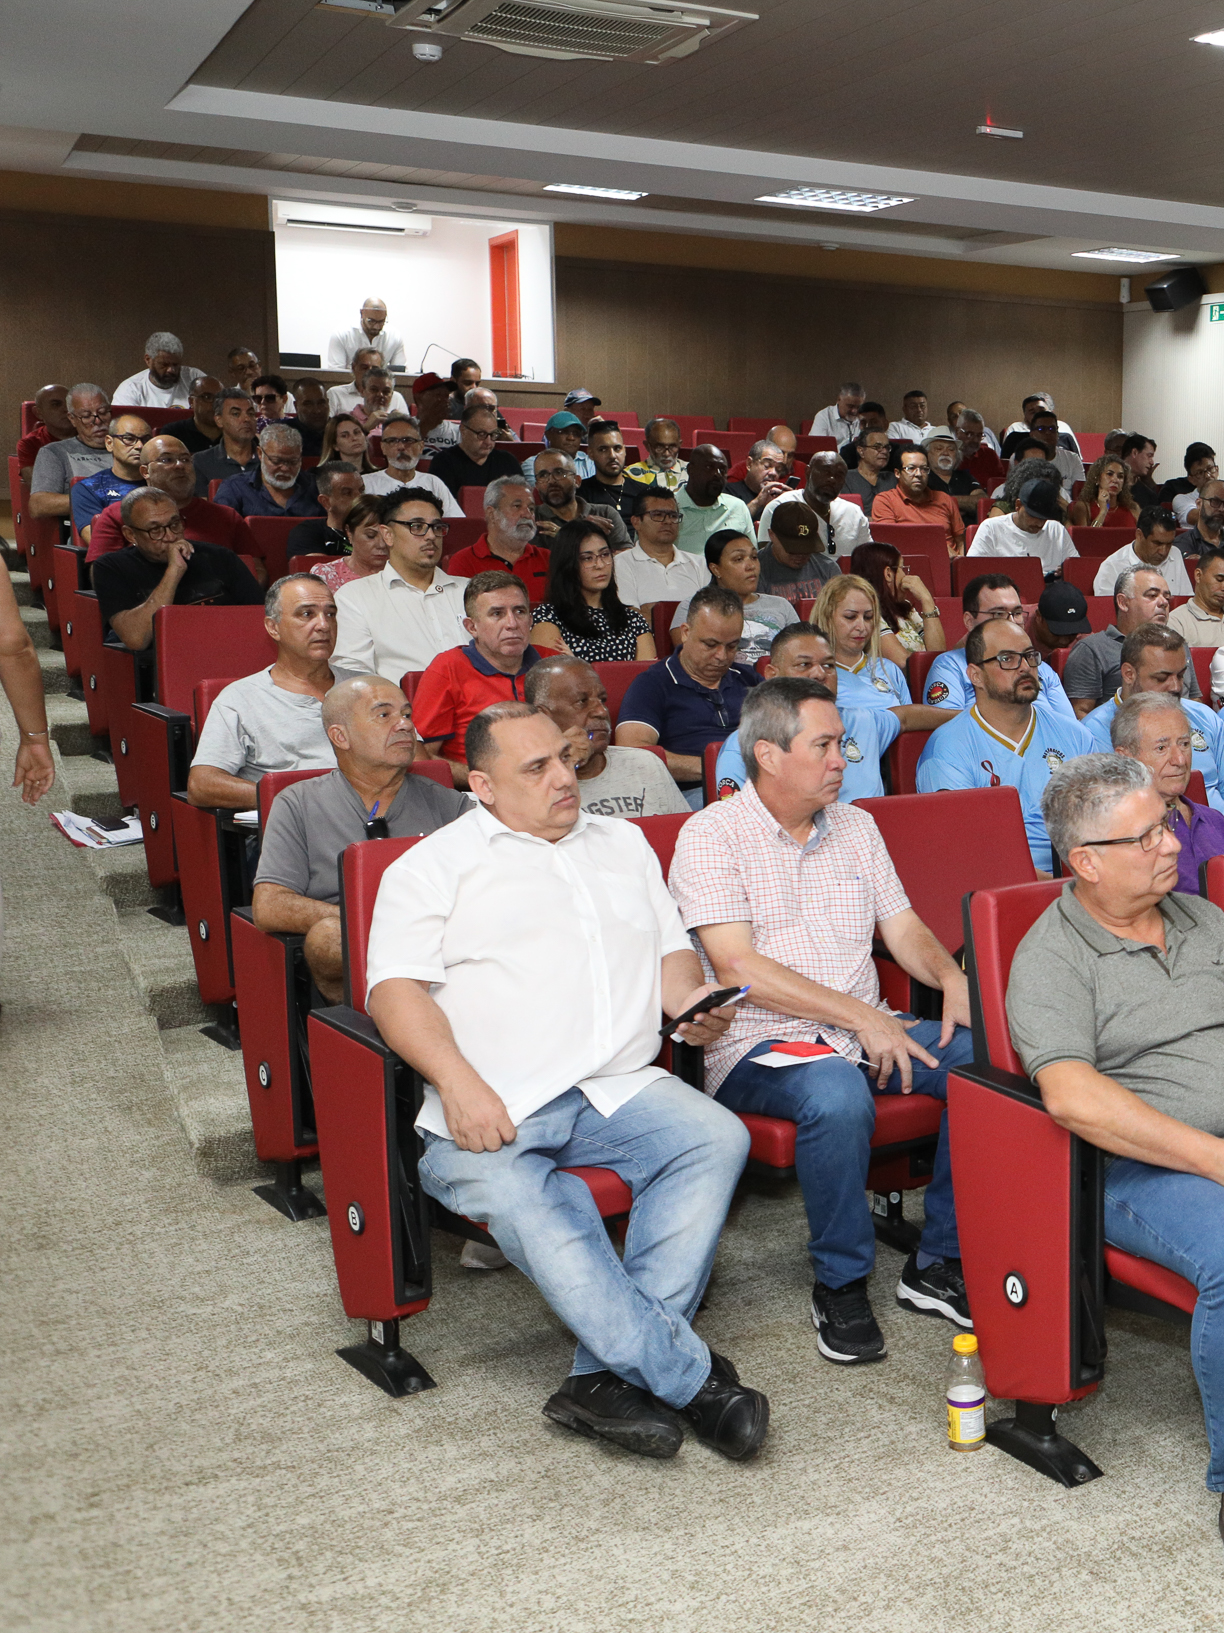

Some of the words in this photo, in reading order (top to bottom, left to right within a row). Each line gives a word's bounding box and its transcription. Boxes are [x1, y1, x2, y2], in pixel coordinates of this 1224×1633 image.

[798, 525, 809, 536] B
[581, 796, 644, 816] GSTER
[351, 1211, 357, 1226] B
[1010, 1282, 1018, 1298] A
